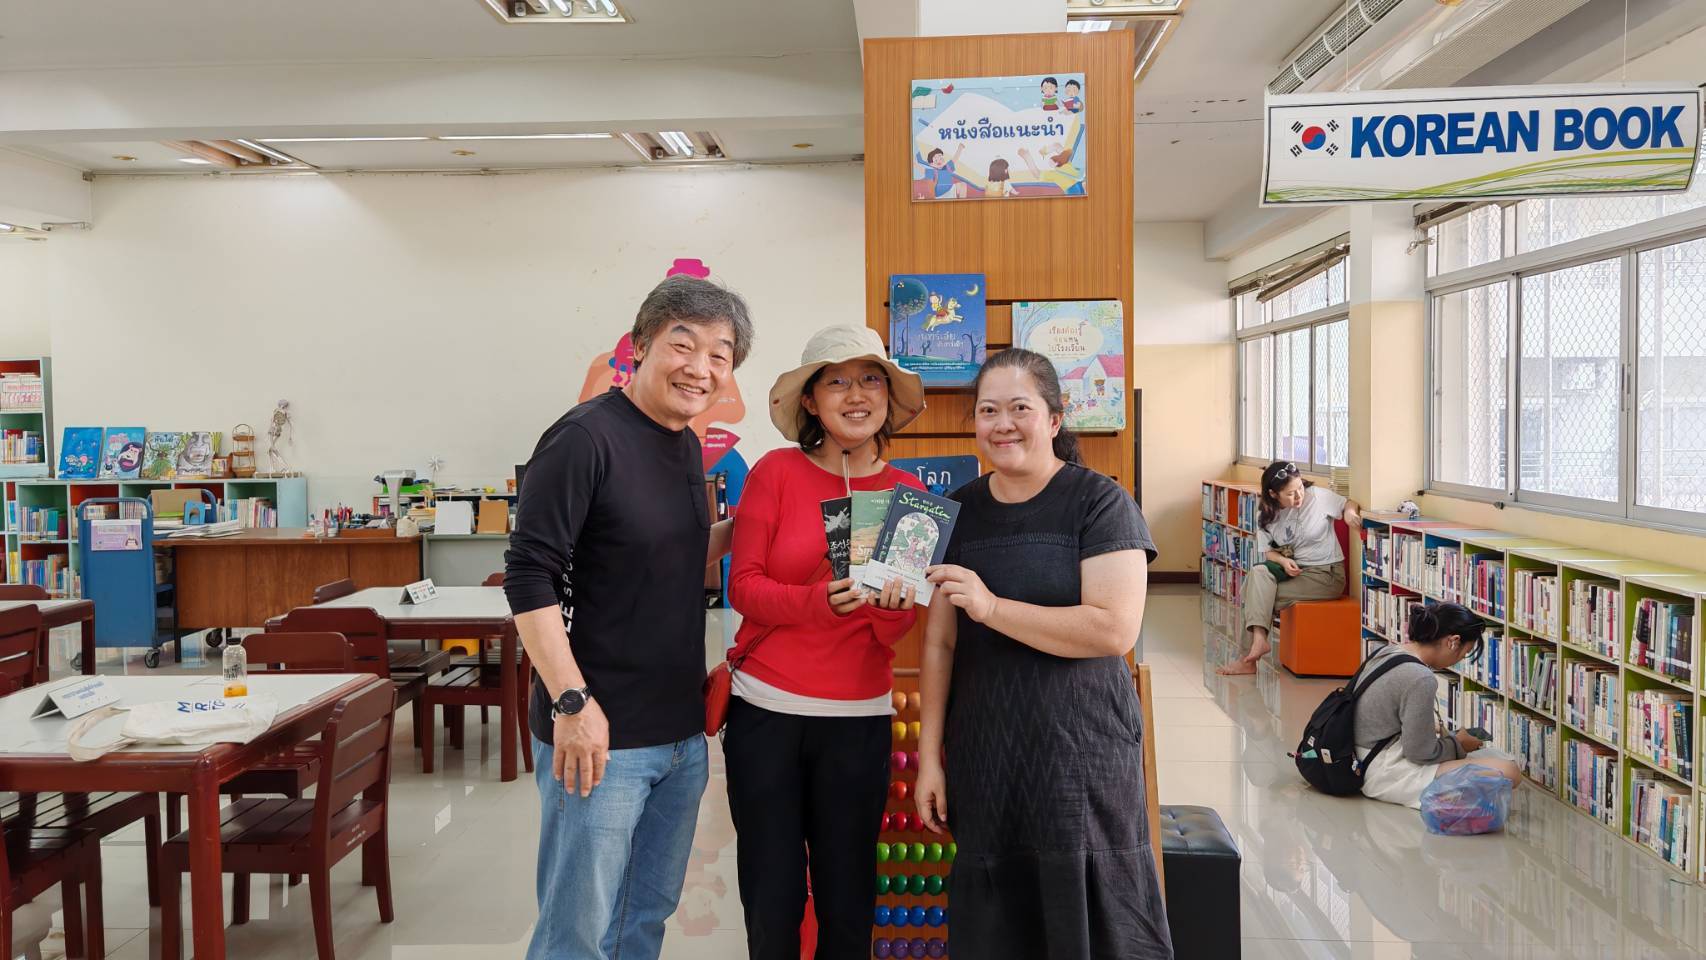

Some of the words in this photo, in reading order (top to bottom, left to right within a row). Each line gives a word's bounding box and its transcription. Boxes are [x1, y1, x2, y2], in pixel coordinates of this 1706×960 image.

[938, 116, 1064, 140] หนังสือแนะนำ
[1350, 110, 1540, 158] KOREAN
[1553, 105, 1686, 152] BOOK
